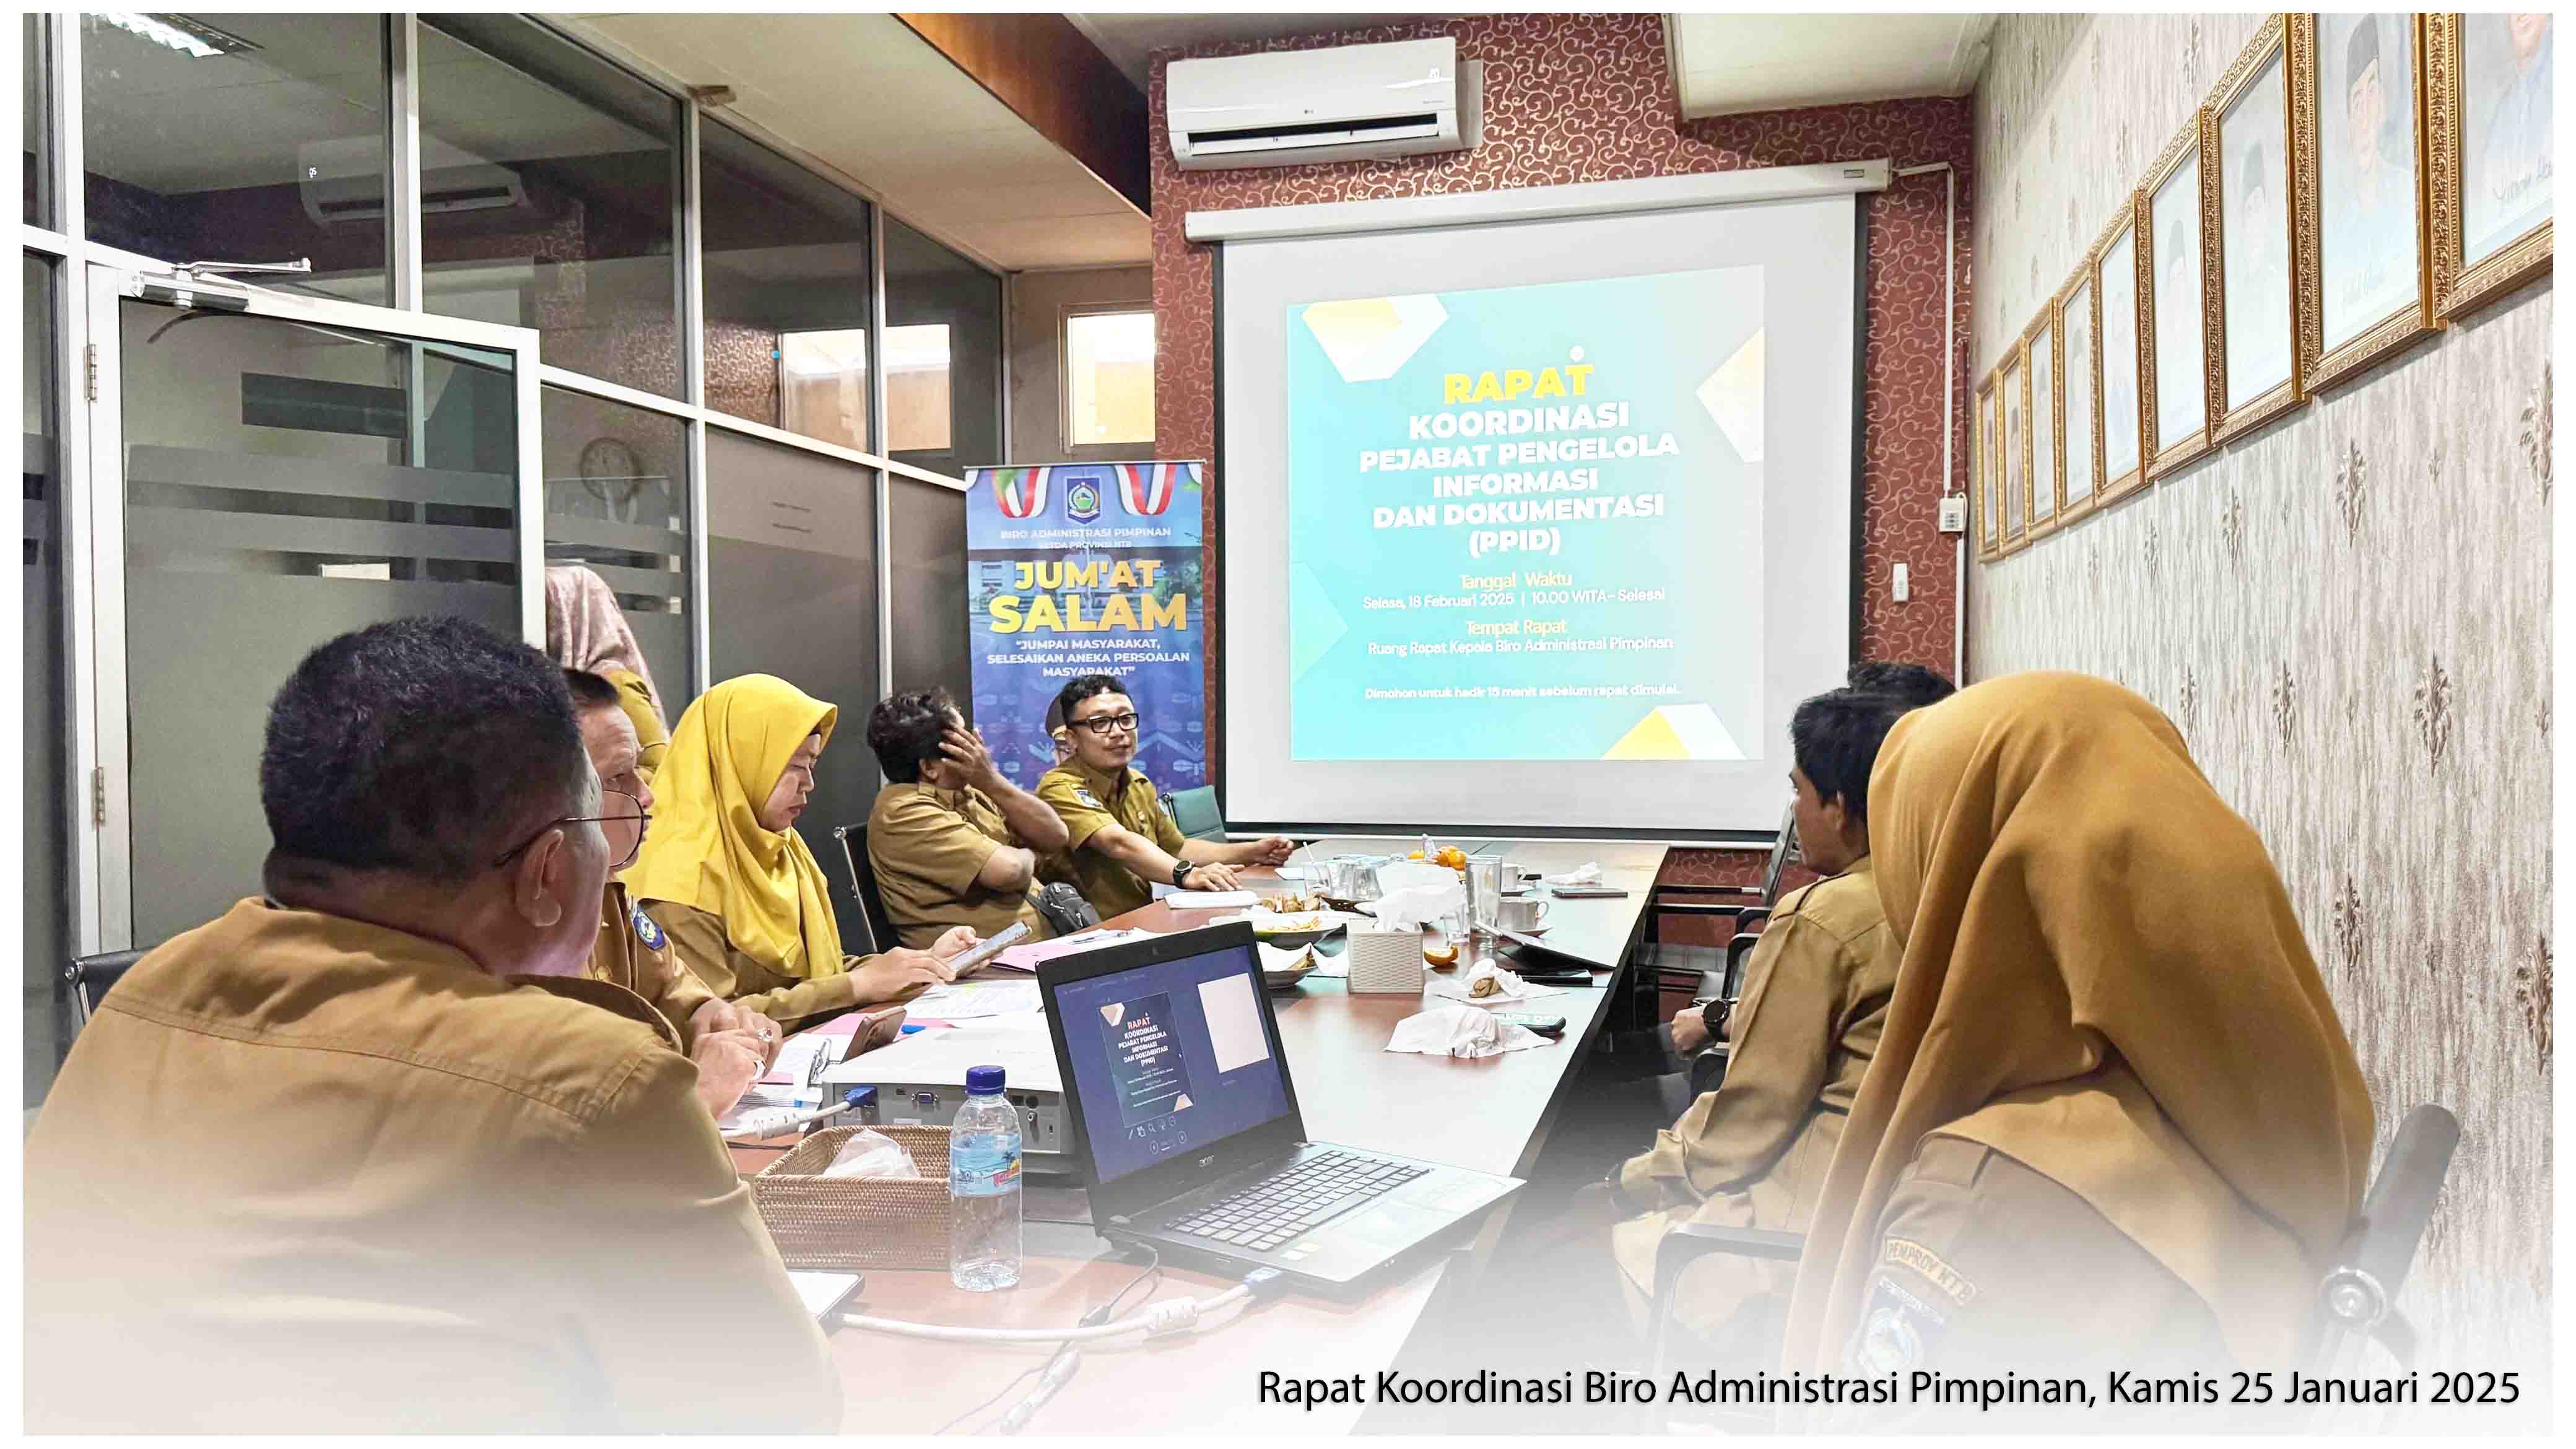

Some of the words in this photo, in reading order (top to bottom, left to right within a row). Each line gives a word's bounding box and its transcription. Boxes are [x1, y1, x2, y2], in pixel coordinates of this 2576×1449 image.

[1443, 363, 1595, 404] RAPAT
[1409, 401, 1630, 440] KOORDINASI
[1359, 444, 1491, 472] PEJABAT
[1499, 433, 1680, 466] PENGELOLA
[1432, 468, 1598, 498] INFORMASI
[1373, 505, 1435, 529] DAN
[1444, 494, 1664, 525] DOKUMENTASI
[1000, 530, 1029, 540] BIRO
[1030, 528, 1111, 539] ADMINISTRASI
[1114, 527, 1172, 537] PIMPINAN
[1468, 528, 1561, 558] (PPID)
[1014, 560, 1162, 590] JUM'AT
[1458, 570, 1516, 591] Tanggal
[1525, 570, 1573, 586] Waktu
[1362, 597, 1406, 609] Selasa,
[1408, 595, 1422, 607] 18
[1424, 593, 1476, 607] Februari
[1479, 592, 1515, 606] 2025
[1531, 590, 1569, 605] 10.00
[1617, 586, 1666, 601] Selesai
[988, 593, 1187, 633] SALAM
[1466, 620, 1520, 638] Tempat
[1523, 619, 1567, 637] Rapat
[1071, 638, 1161, 650] MASYARAKAT,
[1367, 642, 1408, 658] Ruang
[1410, 640, 1448, 657] Rapat
[1450, 639, 1494, 657] Kepala
[1495, 639, 1522, 653] Biro
[1525, 637, 1606, 652] Administrasi
[986, 653, 1064, 664] SELESAIKAN
[1066, 653, 1111, 663] ANEKA
[1114, 651, 1190, 663] PERSOALAN
[1365, 685, 1417, 699] Dimohon
[1418, 684, 1453, 698] untuk
[1595, 684, 1629, 698] rapat
[1124, 1025, 1159, 1040] KOORDINASI
[1127, 1016, 1151, 1030] RAPAT
[1118, 1038, 1140, 1049] PEJABAT
[1140, 1030, 1168, 1043] PENGELOLA
[1123, 1054, 1135, 1063] DAN
[1135, 1045, 1169, 1060] DOKUMENTASI
